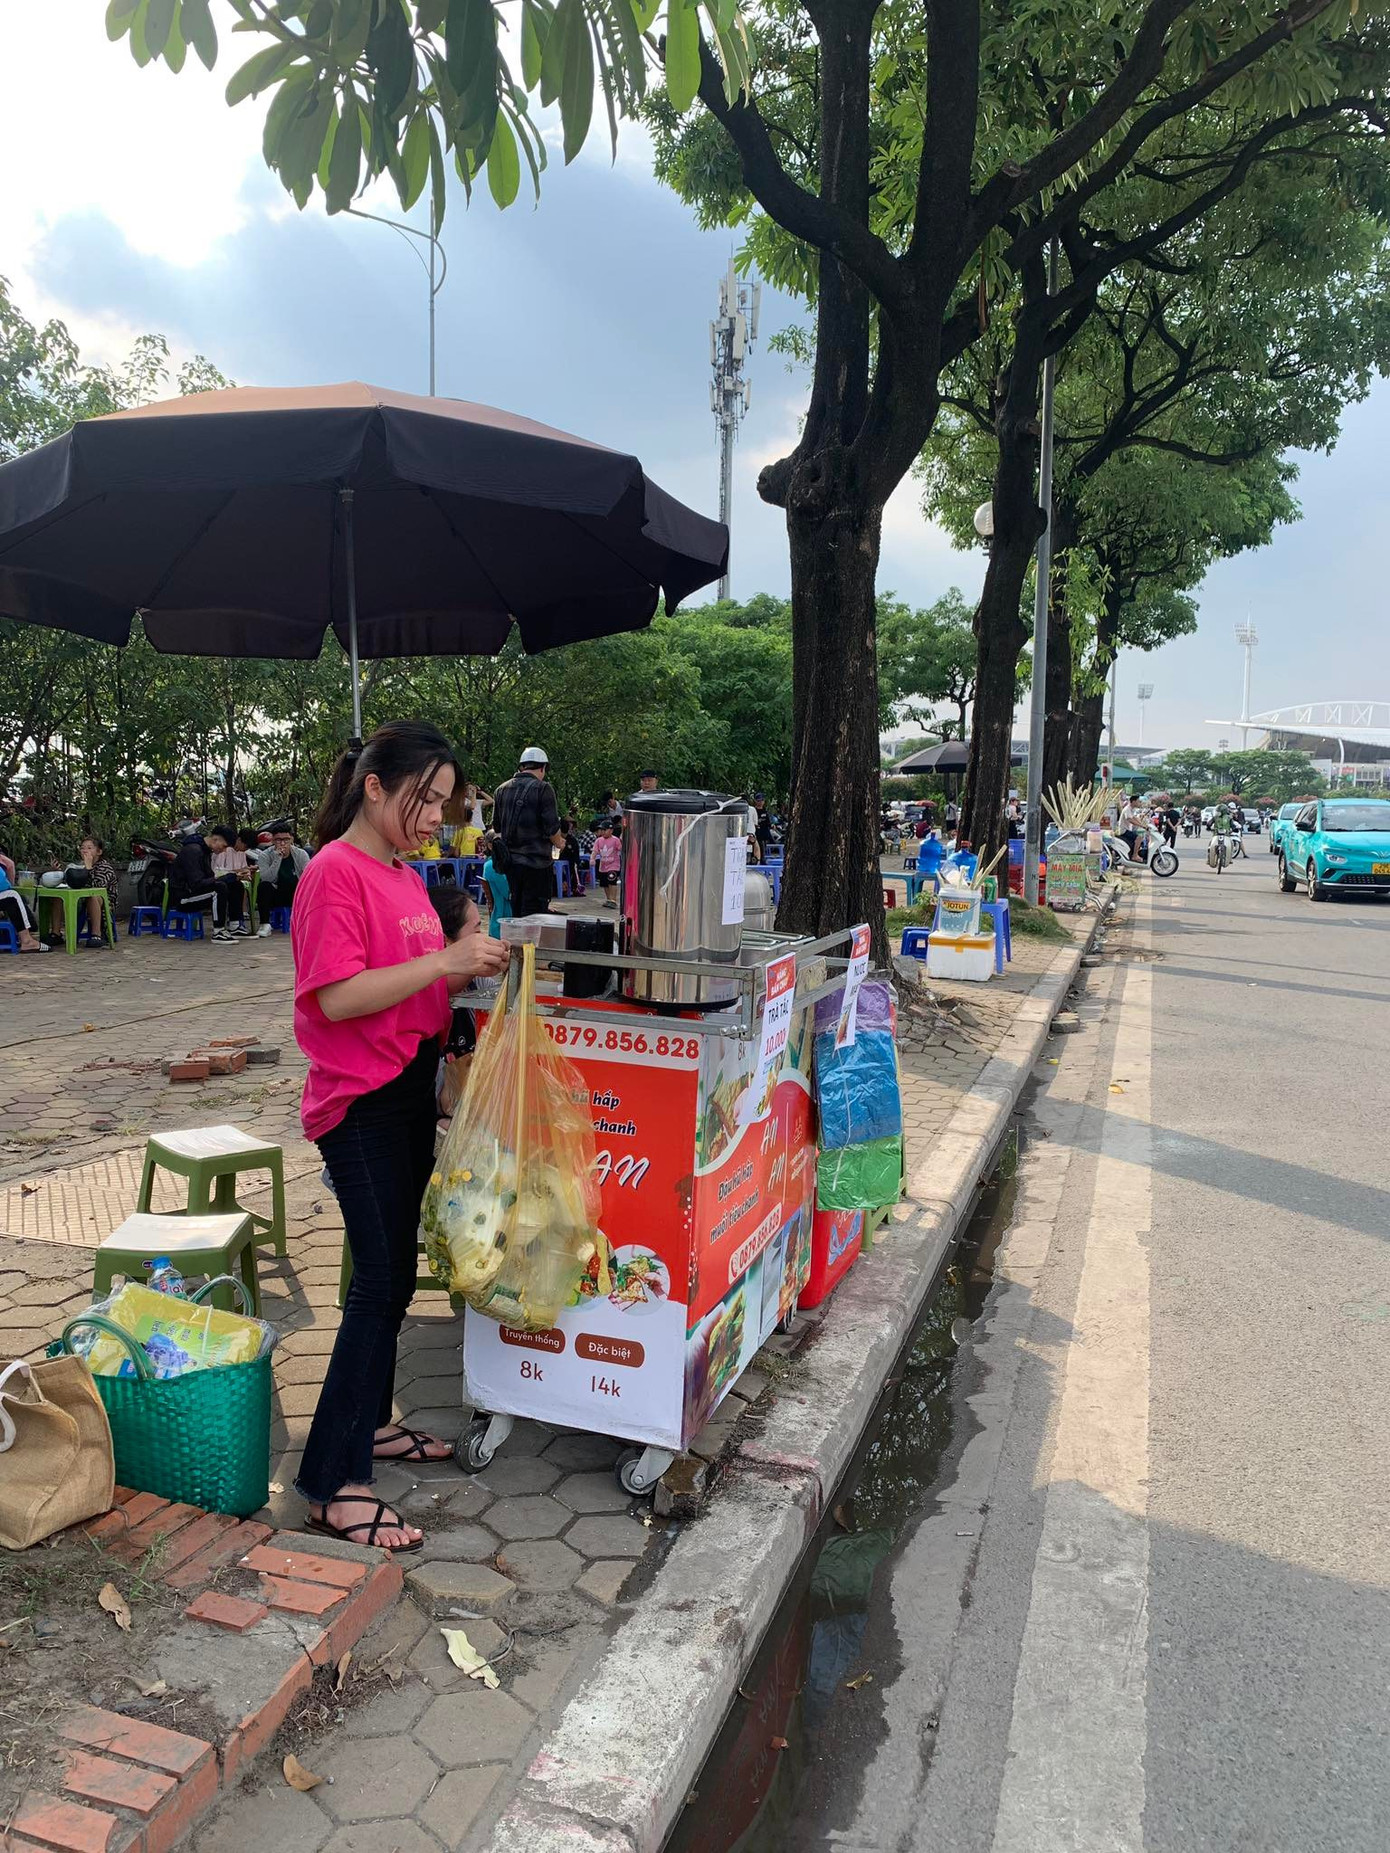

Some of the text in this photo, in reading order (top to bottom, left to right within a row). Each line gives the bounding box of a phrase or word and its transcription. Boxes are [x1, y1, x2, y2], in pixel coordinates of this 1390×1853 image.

[946, 902, 969, 910] JOTUN
[592, 1089, 621, 1111] hấp
[593, 1117, 637, 1136] chanh
[535, 1333, 560, 1349] thống
[588, 1341, 631, 1360] Đặc biệt
[520, 1360, 543, 1381] 8k
[591, 1375, 621, 1397] 14k
